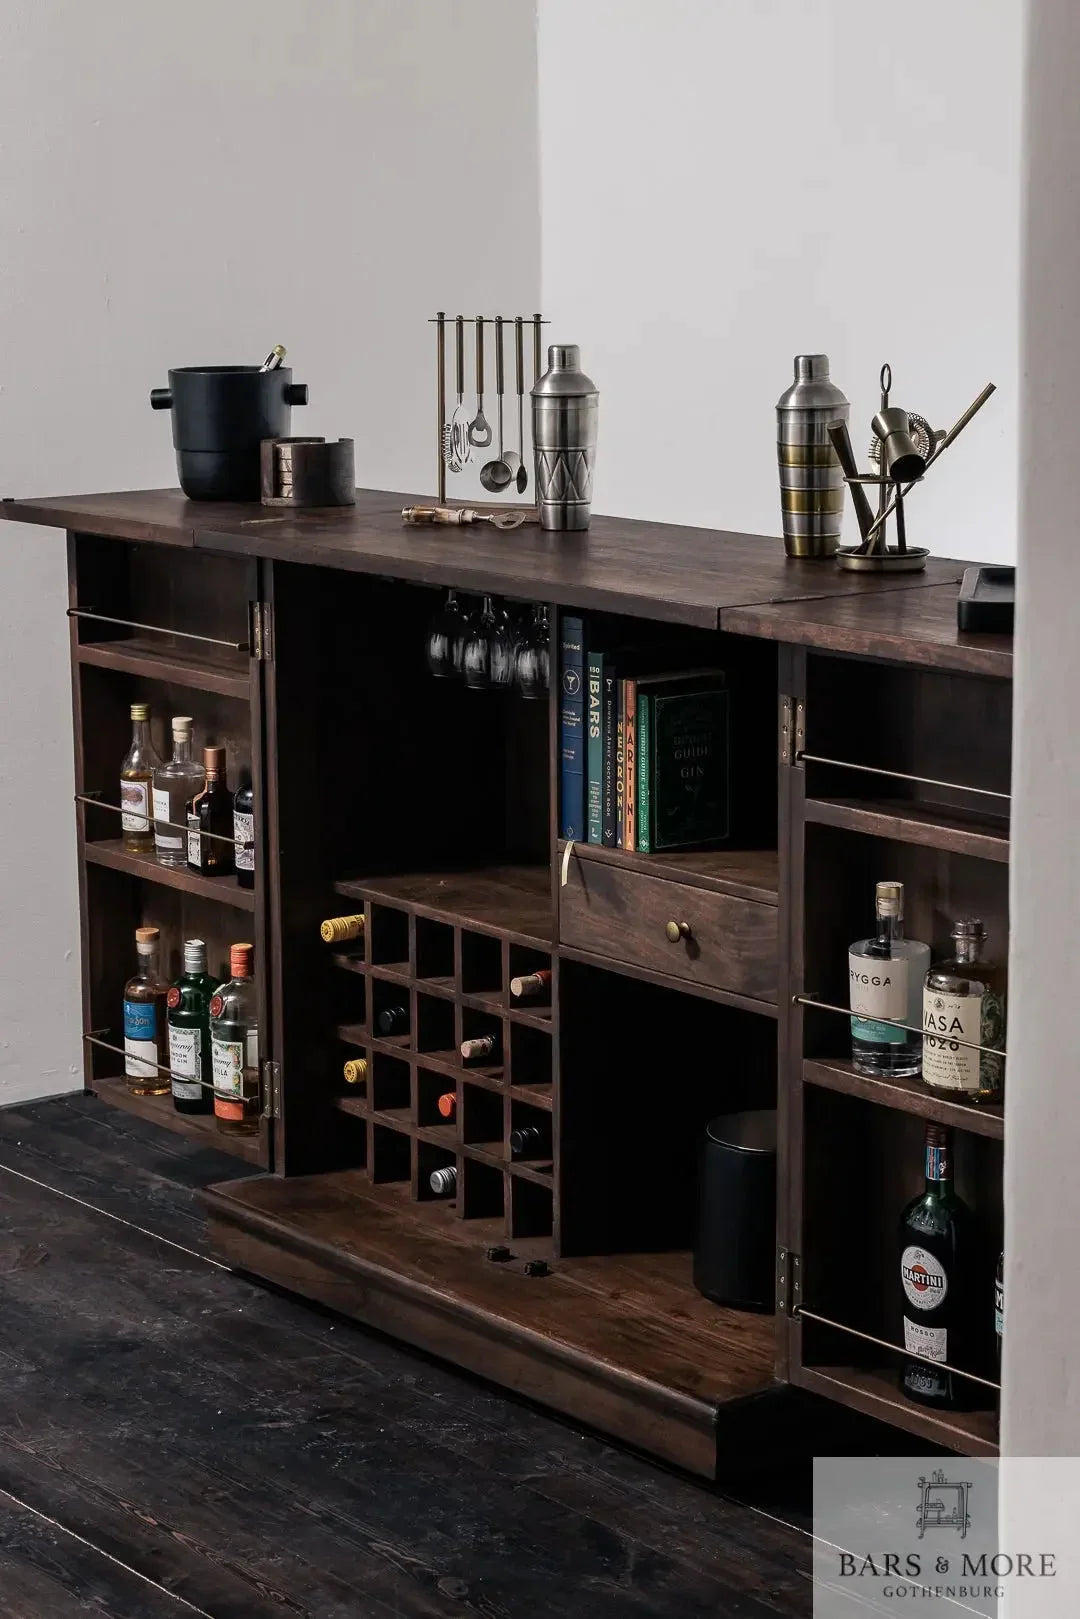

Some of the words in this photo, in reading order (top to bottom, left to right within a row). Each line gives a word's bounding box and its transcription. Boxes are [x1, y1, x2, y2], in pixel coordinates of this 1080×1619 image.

[589, 666, 600, 674] 150
[589, 680, 600, 739] BARS
[616, 721, 624, 822] NEGRONI
[626, 714, 634, 834] MARTINI
[903, 1266, 943, 1287] MARTINI
[910, 1325, 935, 1338] ROSSO
